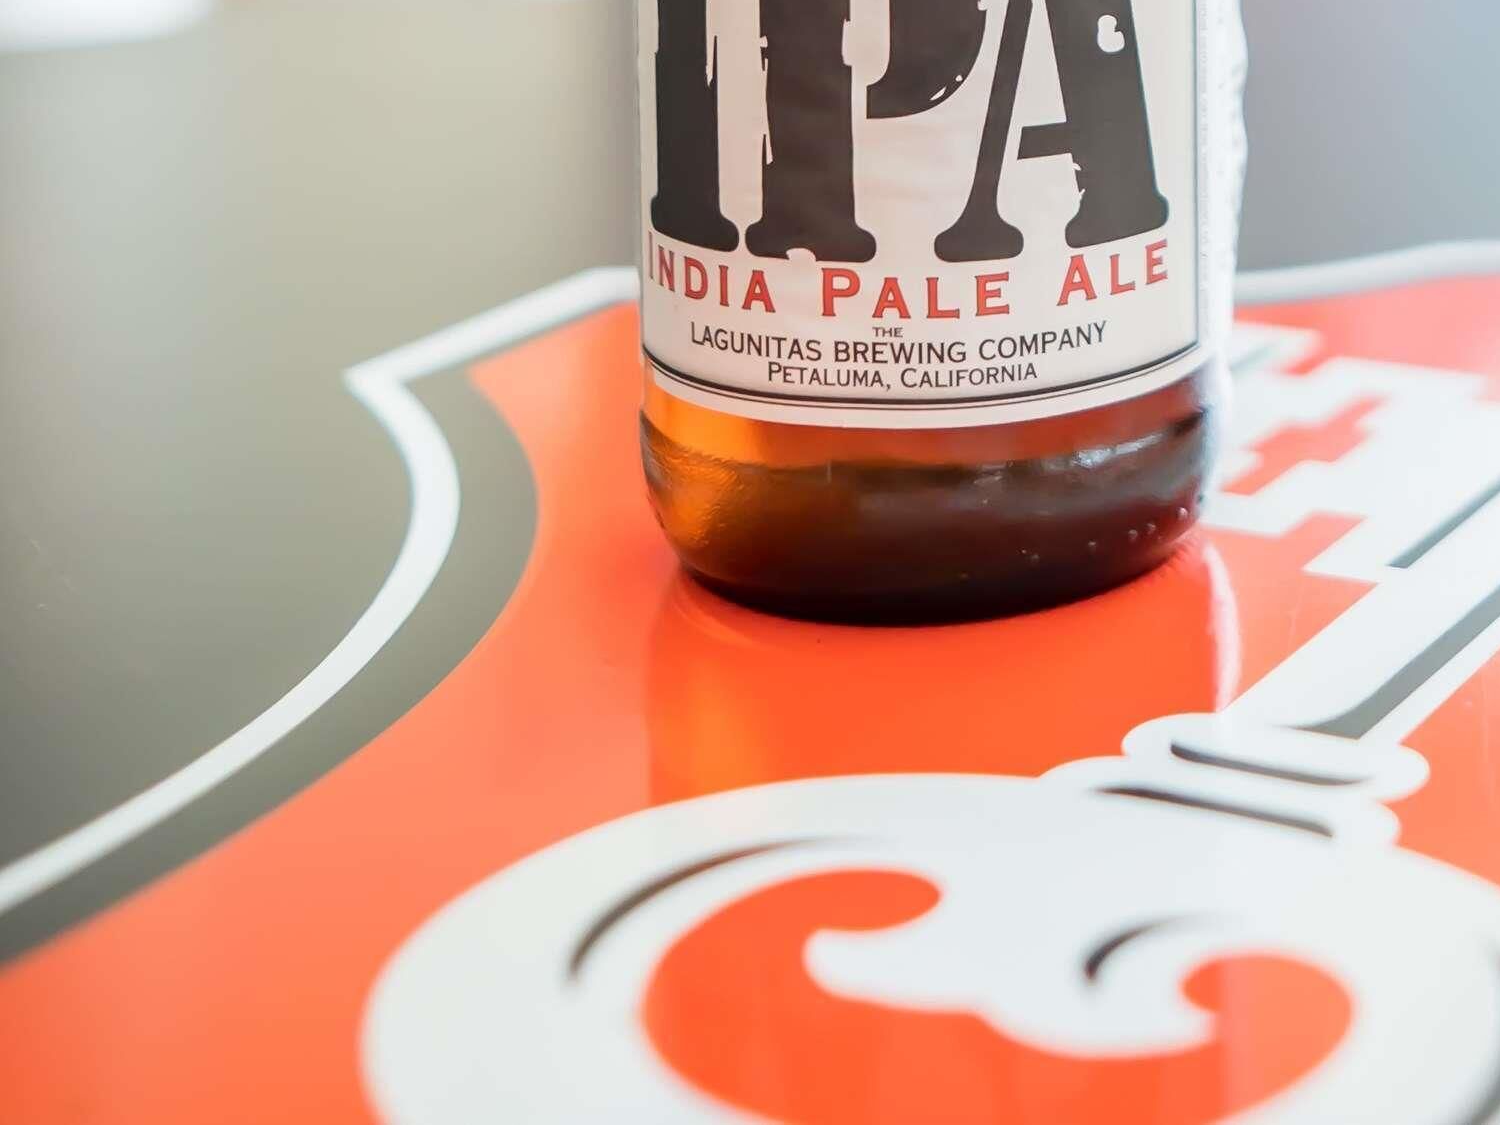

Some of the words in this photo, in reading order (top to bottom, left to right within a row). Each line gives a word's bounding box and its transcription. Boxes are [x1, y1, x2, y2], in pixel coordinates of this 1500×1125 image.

[648, 231, 776, 314] INDIA
[821, 267, 1010, 319] PALE
[1056, 238, 1169, 307] ALE
[691, 321, 822, 361] LAGUNITAS
[834, 340, 967, 365] BREWING
[978, 321, 1108, 361] COMPANY
[872, 326, 903, 338] THE
[768, 361, 891, 390] PETALUMA,
[900, 362, 1038, 389] CALIFORNIA
